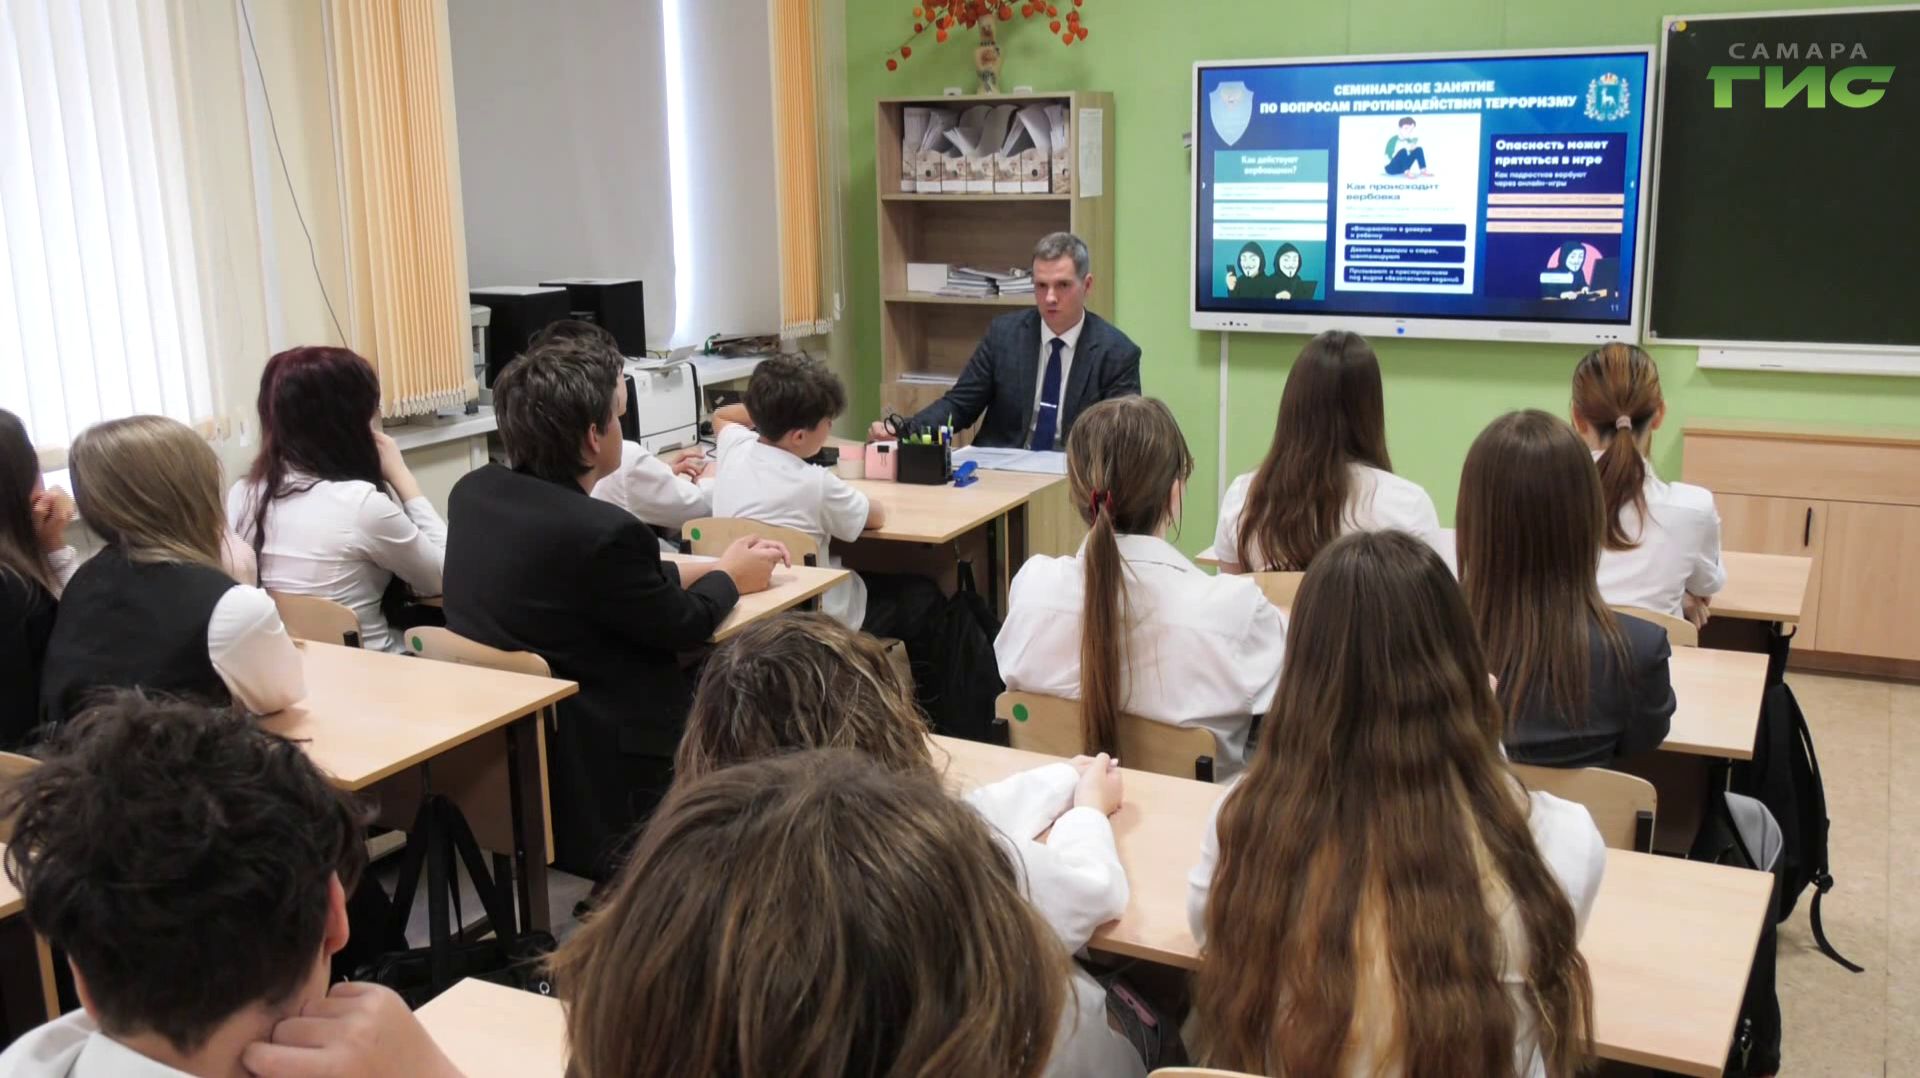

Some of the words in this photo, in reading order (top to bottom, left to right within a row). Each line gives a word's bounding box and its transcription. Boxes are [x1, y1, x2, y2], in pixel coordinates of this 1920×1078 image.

[1333, 82, 1431, 96] СЕМИНАРСКОЕ
[1434, 80, 1495, 94] ЗАНЯТИЕ
[1260, 102, 1278, 114] ПО
[1280, 101, 1350, 113] ВОПРОСАМ
[1353, 96, 1482, 113] ПРОТИВОДЕЙСТВИЯ
[1485, 96, 1577, 109] ТЕРРОРИЗМУ
[1495, 139, 1565, 151] Опасность
[1567, 140, 1609, 150] может
[1495, 156, 1559, 167] прятаться
[1561, 156, 1569, 165] в
[1572, 155, 1603, 167] игре
[1369, 183, 1440, 193] происходит
